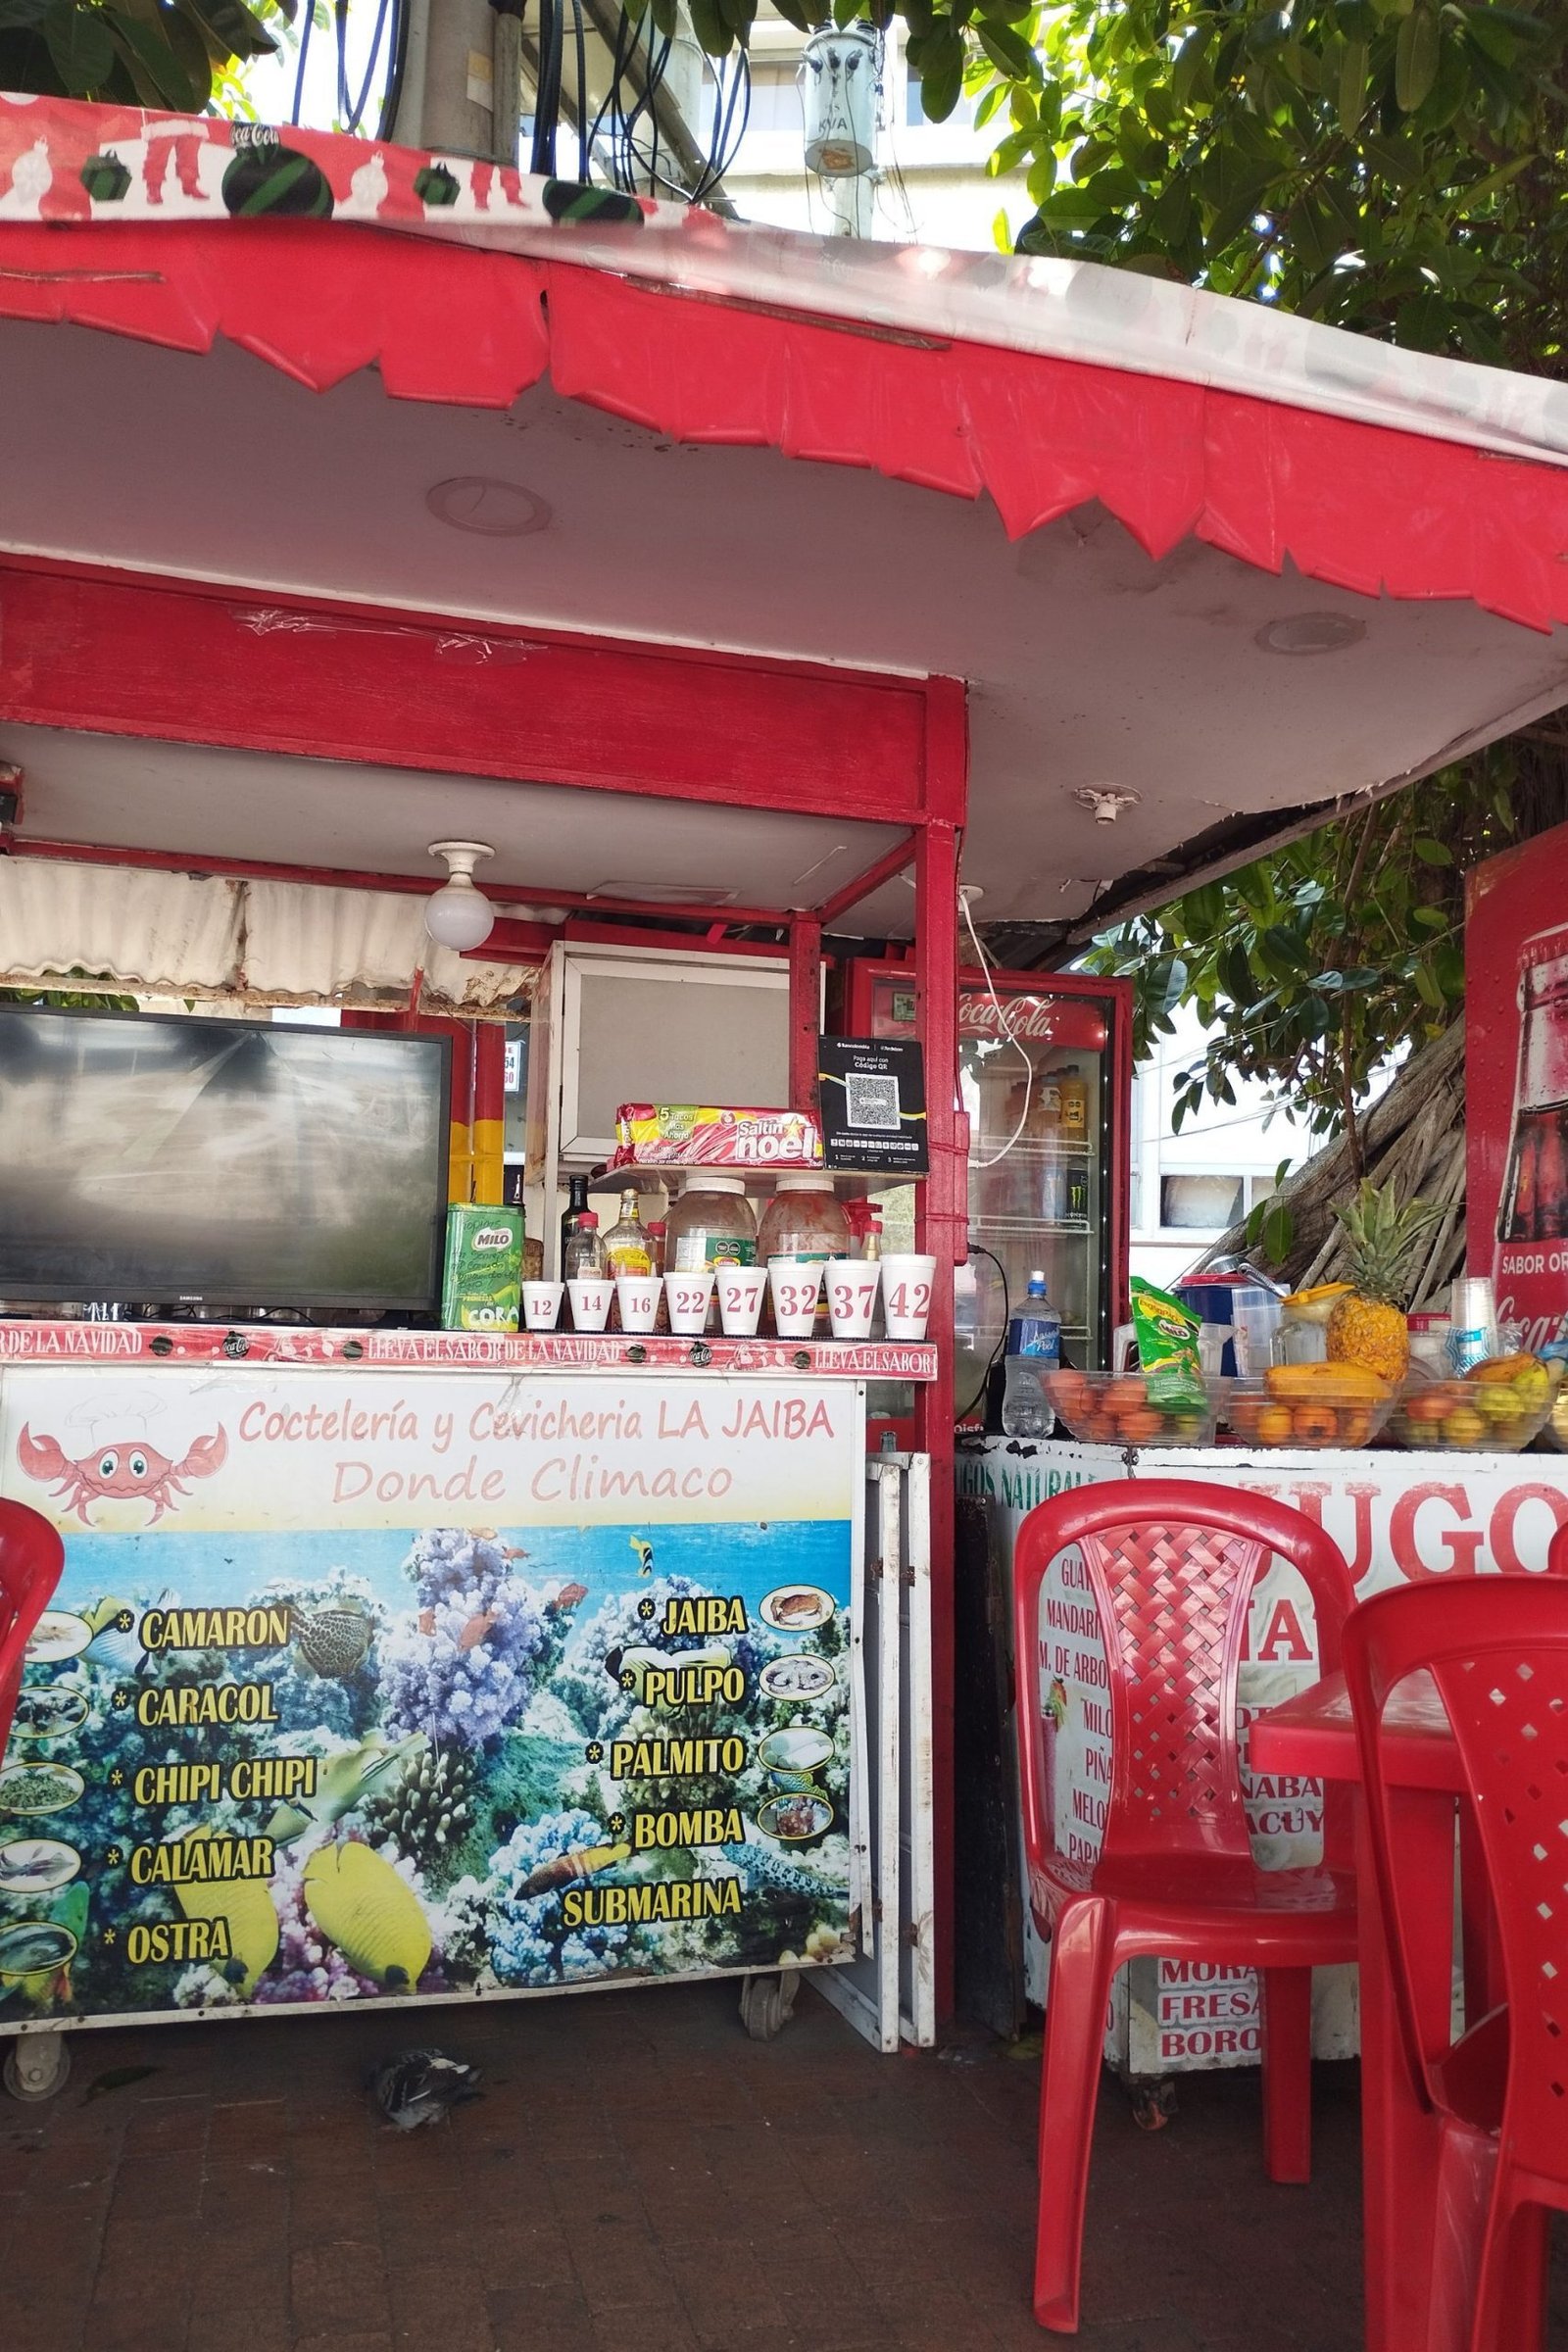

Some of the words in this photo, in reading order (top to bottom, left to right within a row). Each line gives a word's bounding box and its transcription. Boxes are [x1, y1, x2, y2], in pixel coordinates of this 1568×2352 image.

[659, 1107, 669, 1120] 5
[737, 1126, 816, 1160] noel
[477, 1234, 510, 1246] MILO
[1501, 1254, 1545, 1274] SABOR
[531, 1298, 552, 1316] 12
[581, 1295, 602, 1311] 14
[630, 1297, 651, 1314] 16
[675, 1291, 705, 1314] 22
[726, 1287, 759, 1313] 27
[779, 1284, 817, 1317] 32
[834, 1284, 875, 1319] 37
[889, 1282, 930, 1319] 42
[9, 1330, 32, 1353] DE
[35, 1331, 58, 1353] LA
[64, 1330, 142, 1354] NAVIDAD
[368, 1337, 420, 1360] LLEVA
[423, 1339, 445, 1360] EL
[446, 1340, 503, 1360] SABOR
[505, 1341, 526, 1361] DE
[528, 1340, 550, 1361] LA
[552, 1340, 620, 1362] NAVIDAD
[815, 1347, 859, 1369] LLEVA
[862, 1349, 881, 1370] EL
[882, 1351, 930, 1373] SABOR
[238, 1398, 419, 1444] Coctelería
[432, 1412, 454, 1453] y
[468, 1399, 643, 1442] Cevicheria
[657, 1400, 710, 1440] LA
[721, 1398, 836, 1440] JAIBA
[333, 1455, 507, 1504] Donde
[530, 1453, 733, 1501] Climaco
[142, 1608, 289, 1648] CAMARON
[662, 1599, 746, 1635] JAIBA
[1055, 1645, 1070, 1678] DE
[1074, 1651, 1110, 1690] ARBO
[646, 1668, 745, 1704] PULPO
[138, 1685, 277, 1725] CARACOL
[612, 1739, 744, 1777] PALMITO
[134, 1763, 220, 1805] CHIPI
[231, 1758, 317, 1800] CHIPI
[634, 1809, 743, 1847] BOMBA
[1072, 1788, 1108, 1832] MELO
[131, 1838, 273, 1884] CALAMAR
[564, 1880, 742, 1926] SUBMARINA
[127, 1921, 229, 1964] OSTRA
